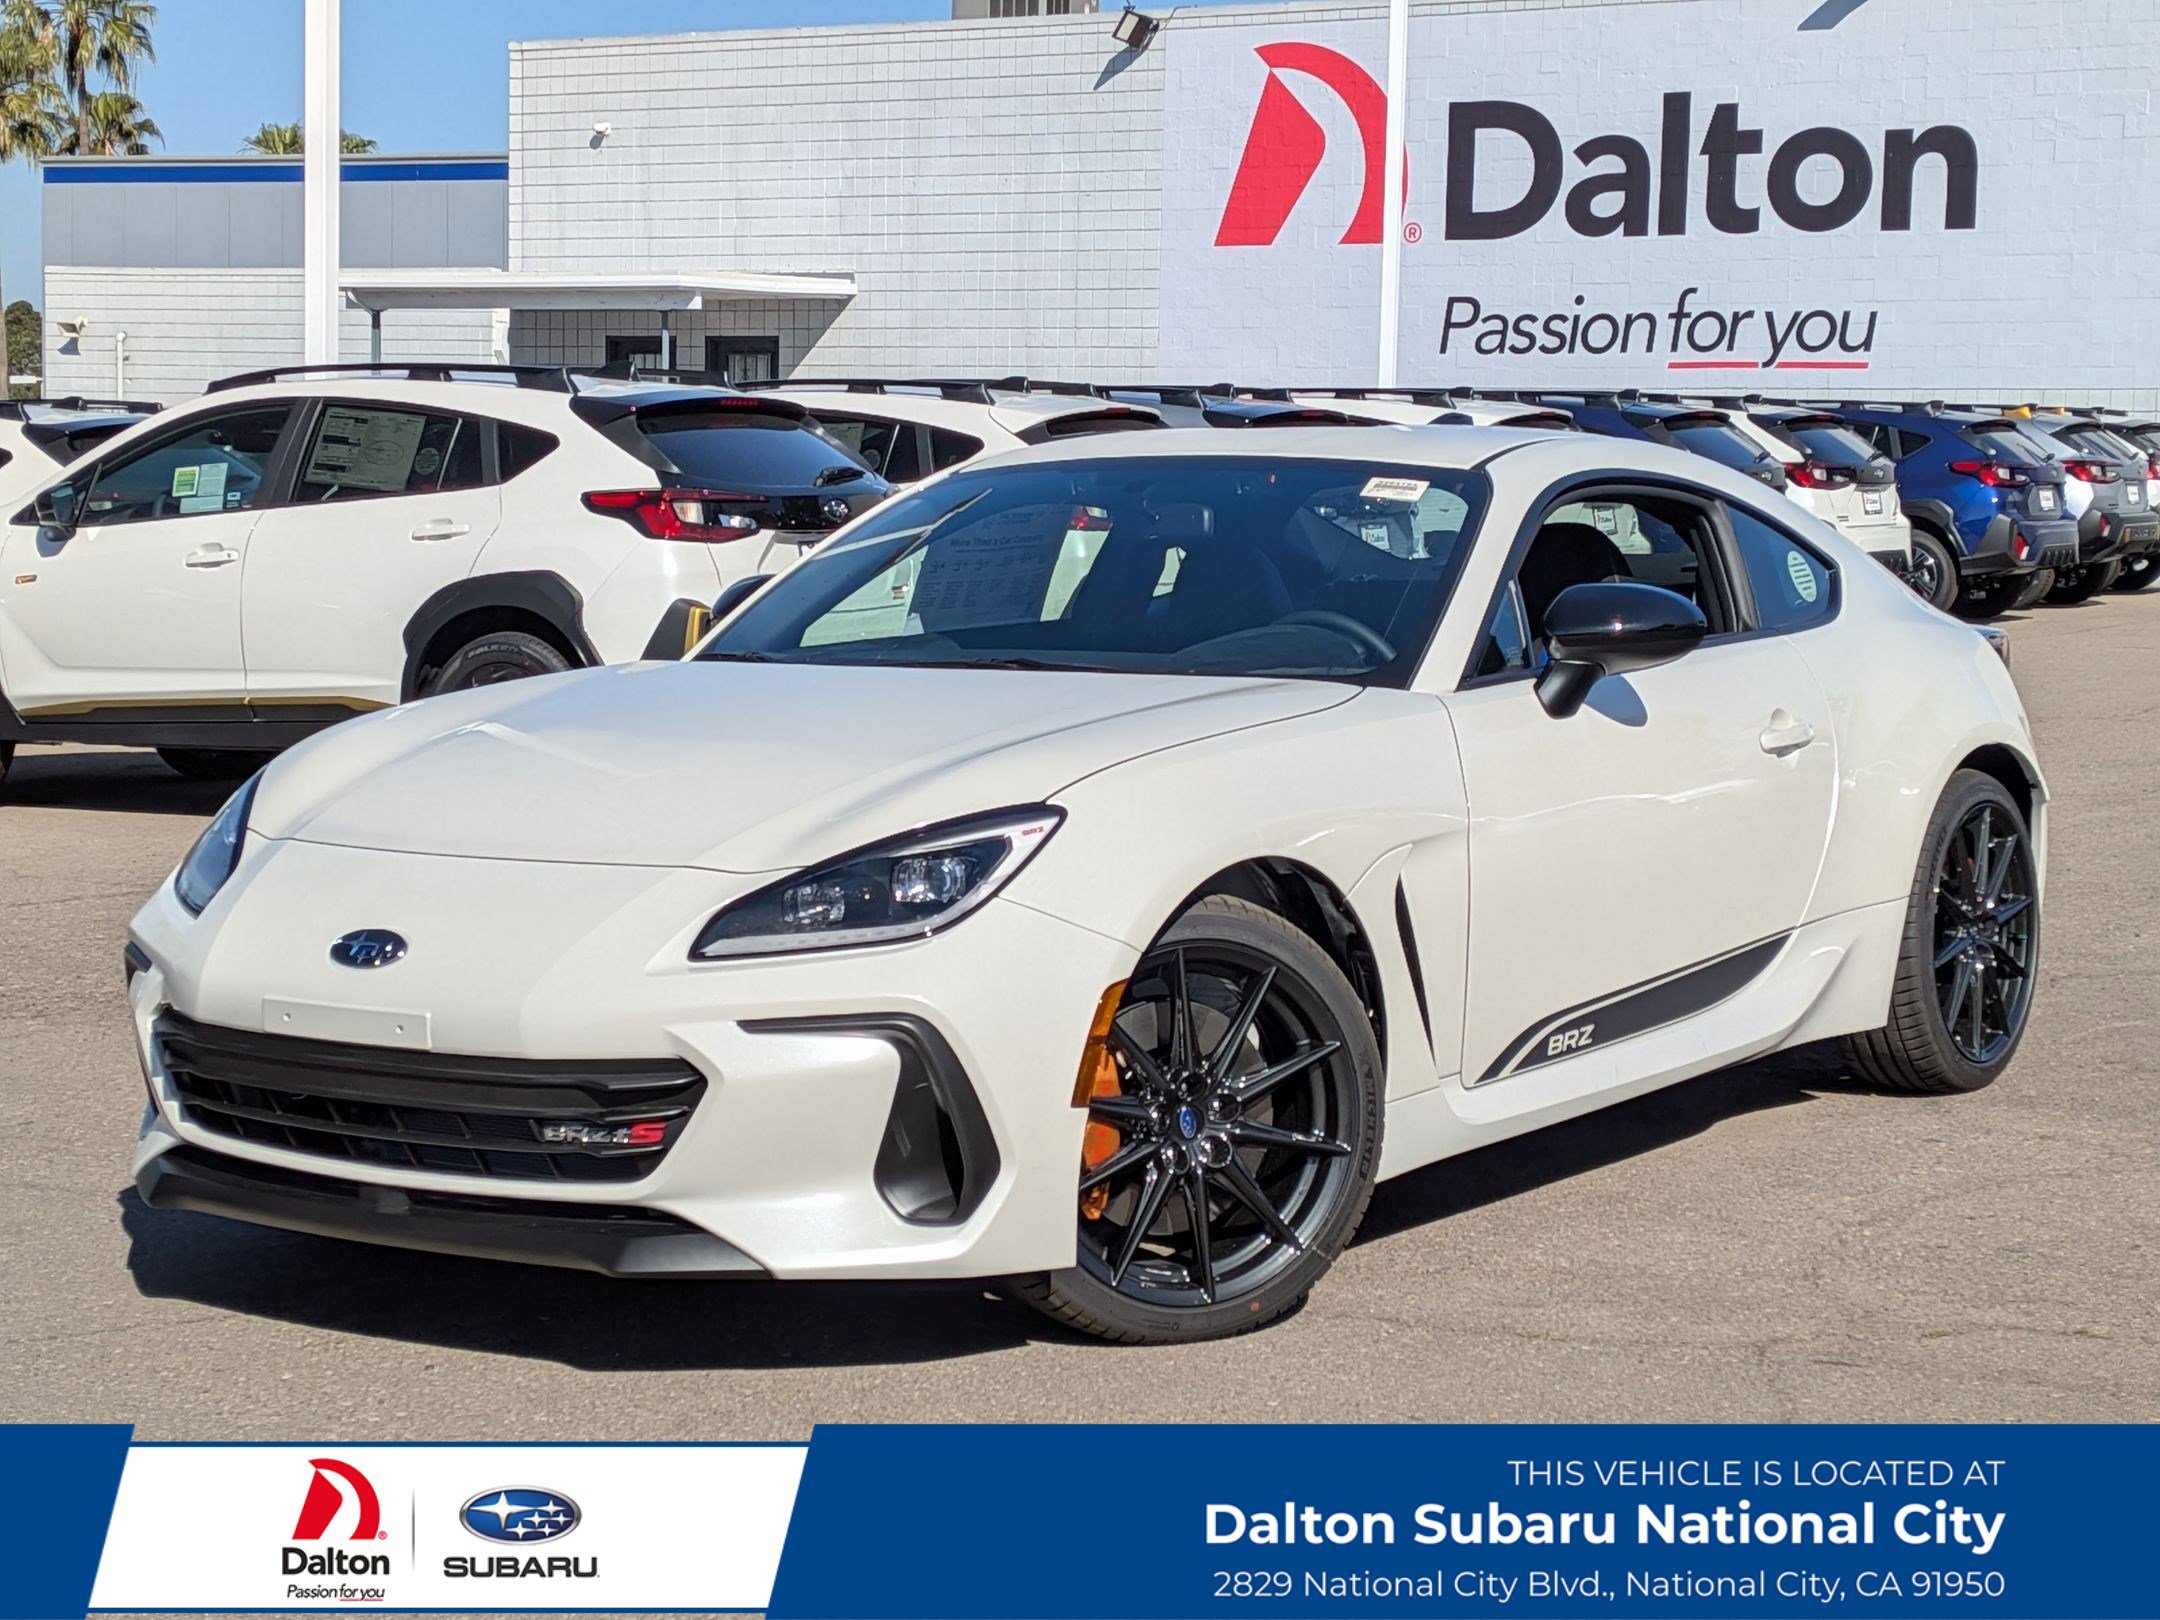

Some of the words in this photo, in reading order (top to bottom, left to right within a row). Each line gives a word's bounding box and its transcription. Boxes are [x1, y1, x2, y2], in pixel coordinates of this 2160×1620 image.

[1445, 91, 1978, 240] Dalton
[1439, 294, 1657, 355] Passion
[1667, 287, 1755, 353] for
[1761, 310, 1878, 368] you
[1547, 1023, 1596, 1057] BRZ
